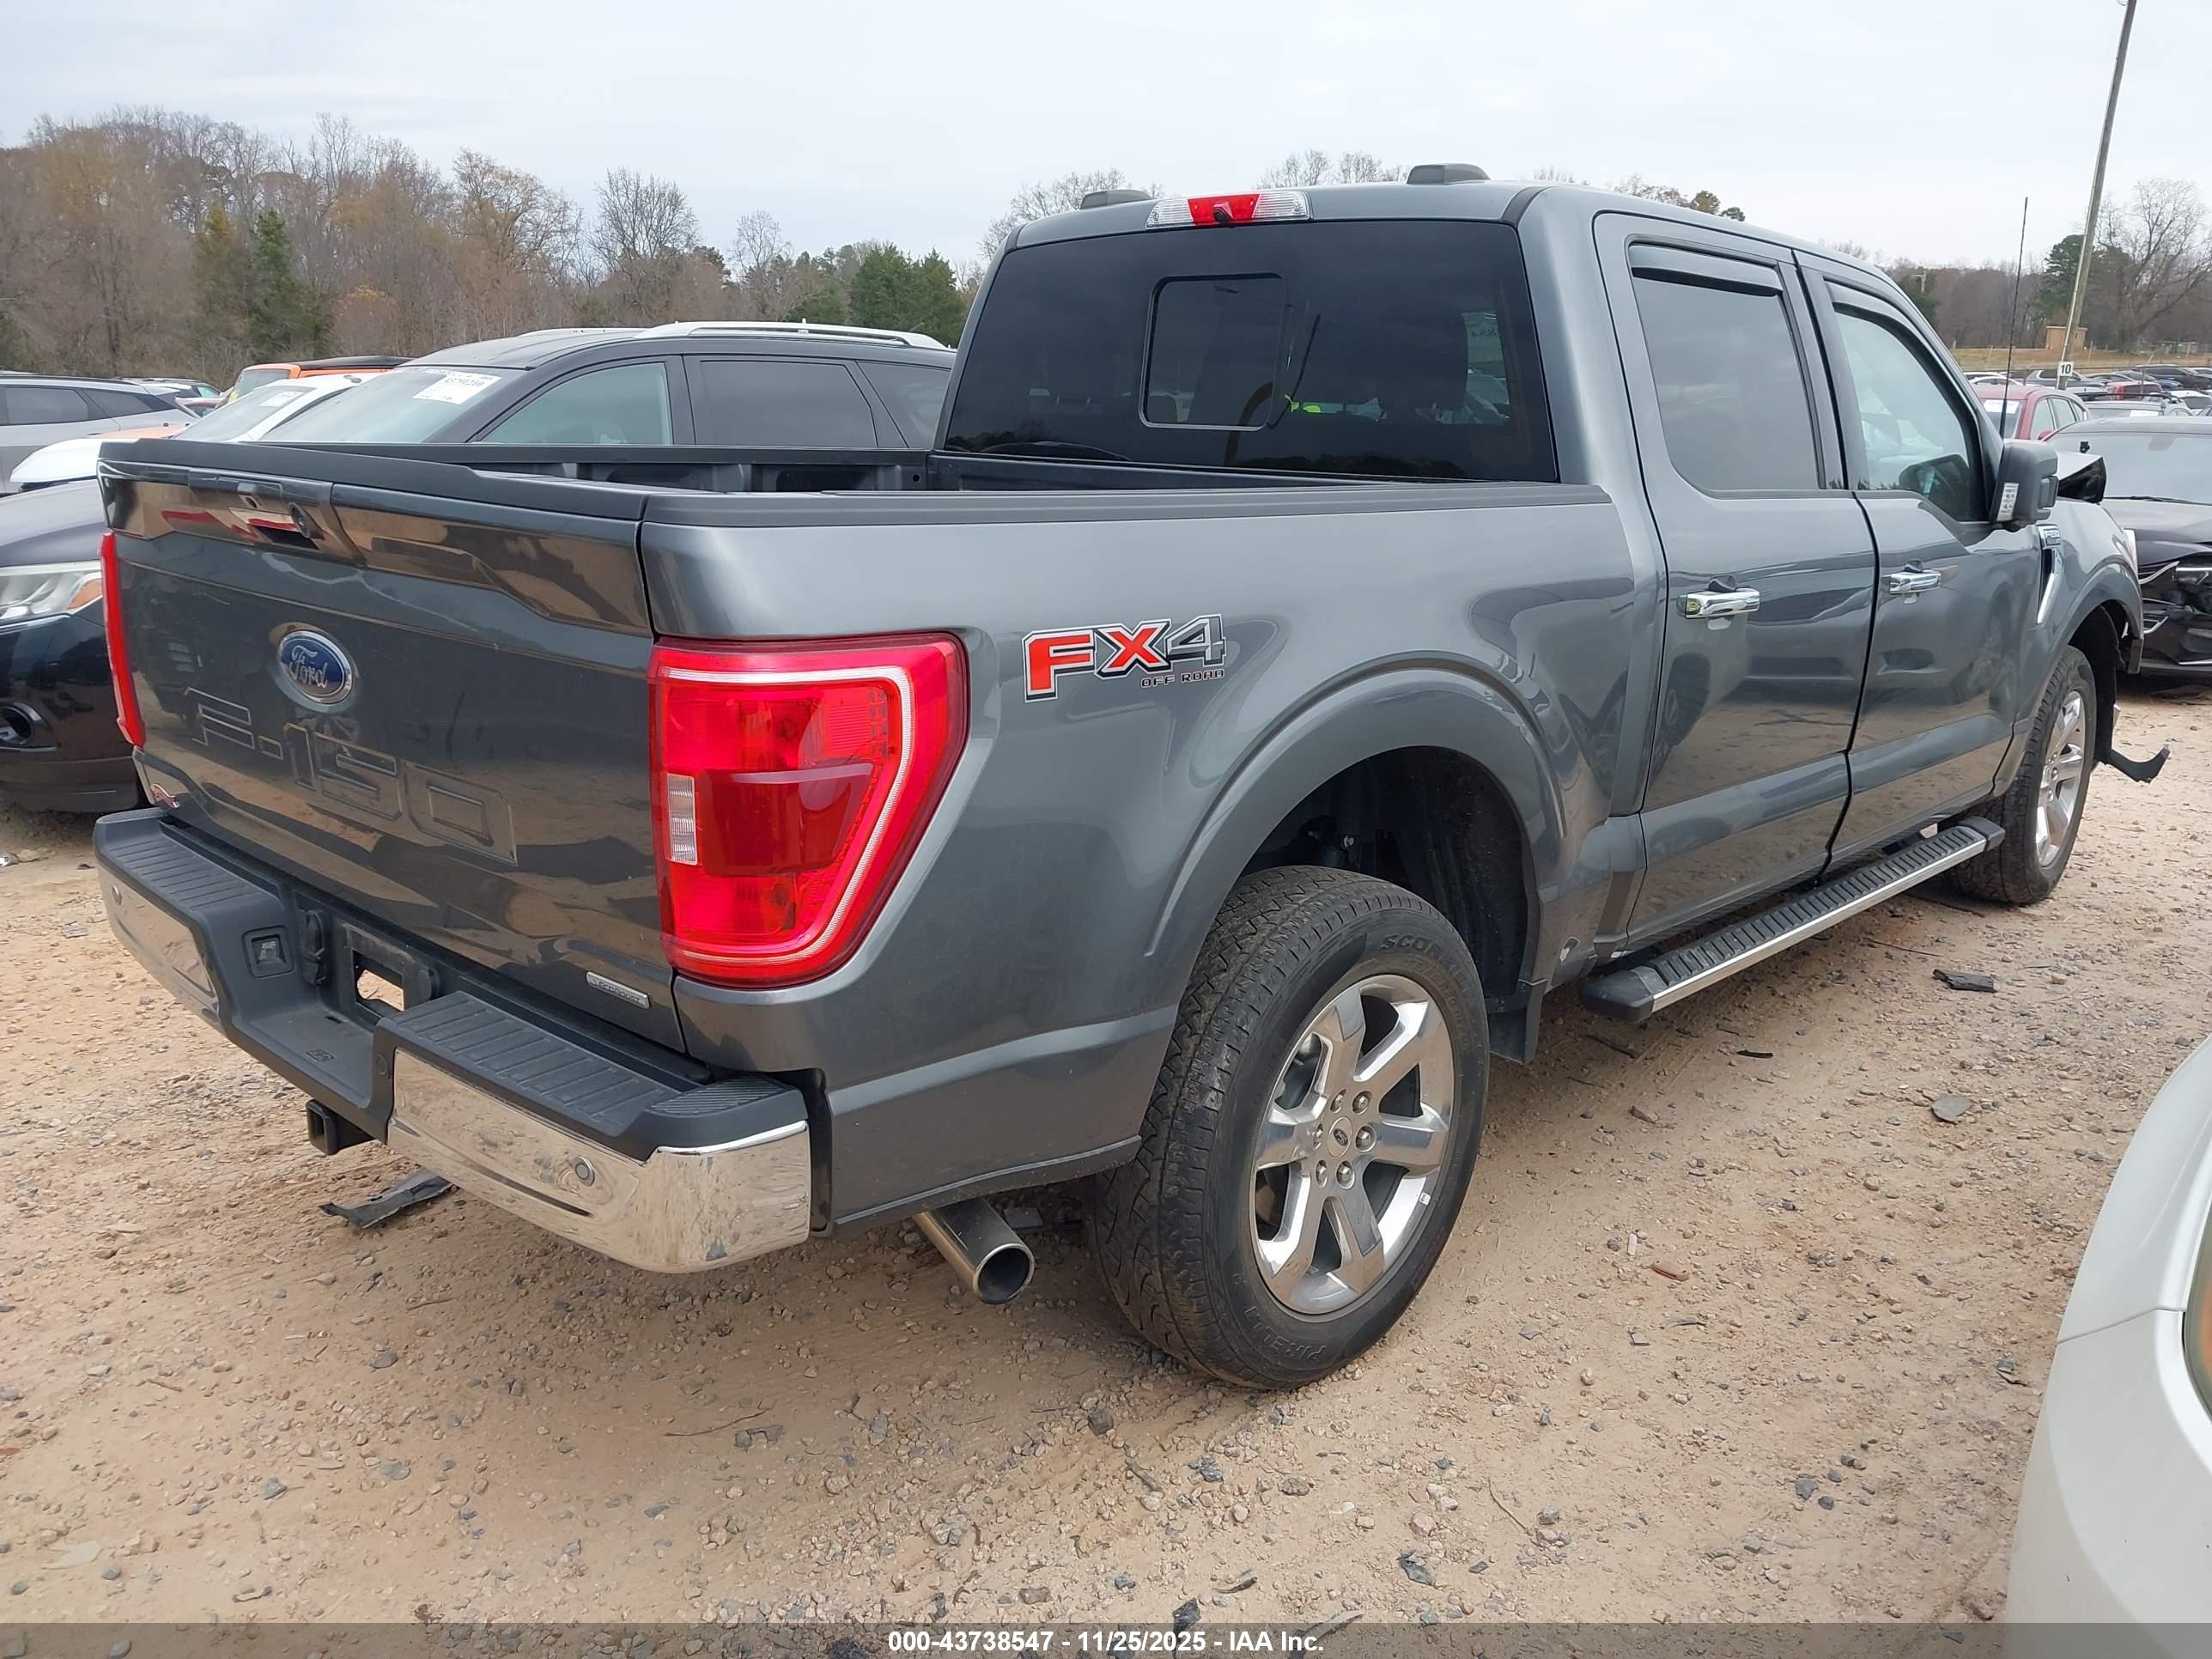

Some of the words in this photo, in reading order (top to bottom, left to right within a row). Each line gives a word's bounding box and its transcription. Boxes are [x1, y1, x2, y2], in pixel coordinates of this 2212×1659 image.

[2061, 363, 2072, 374] 10
[289, 644, 328, 689] Ford
[1022, 614, 1226, 702] FX4
[1141, 674, 1176, 688] OFF
[1181, 669, 1224, 684] ROAD
[183, 687, 518, 866] F-150
[1244, 1305, 1327, 1361] PIRELLI
